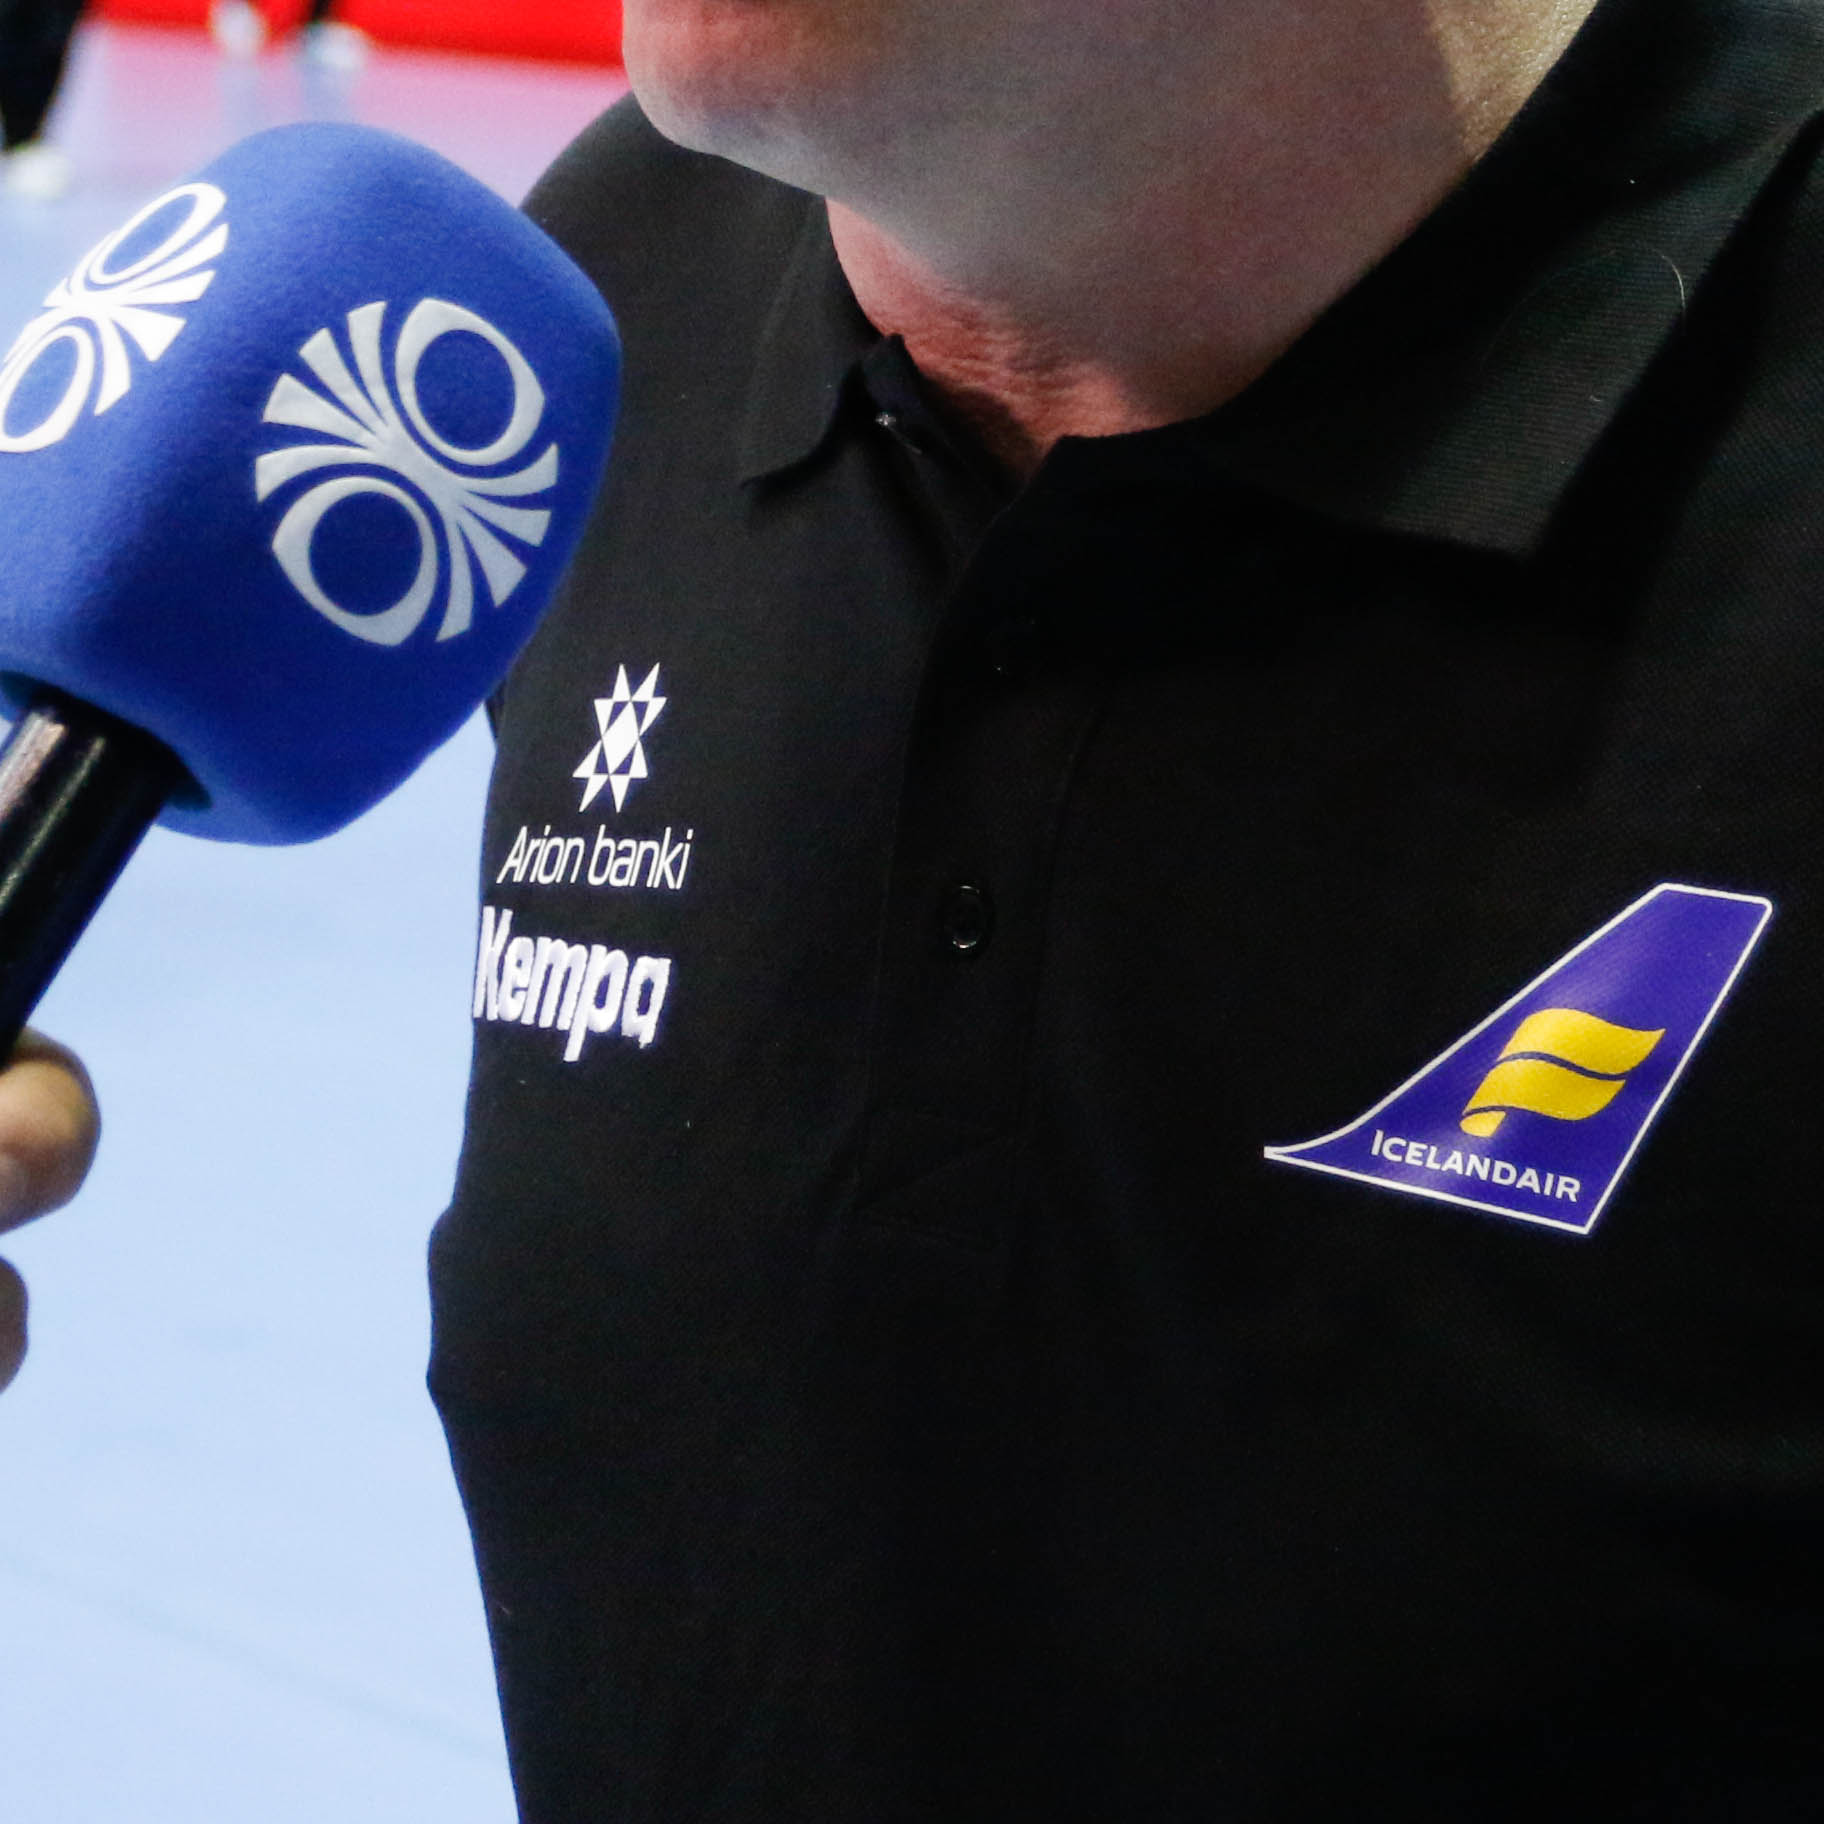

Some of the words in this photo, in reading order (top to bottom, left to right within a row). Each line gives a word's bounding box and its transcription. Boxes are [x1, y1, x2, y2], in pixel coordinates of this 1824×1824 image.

[495, 824, 586, 885] Arion
[587, 823, 695, 890] banki
[472, 906, 672, 1063] Kempa
[1370, 1128, 1582, 1204] ICELANDAIR
